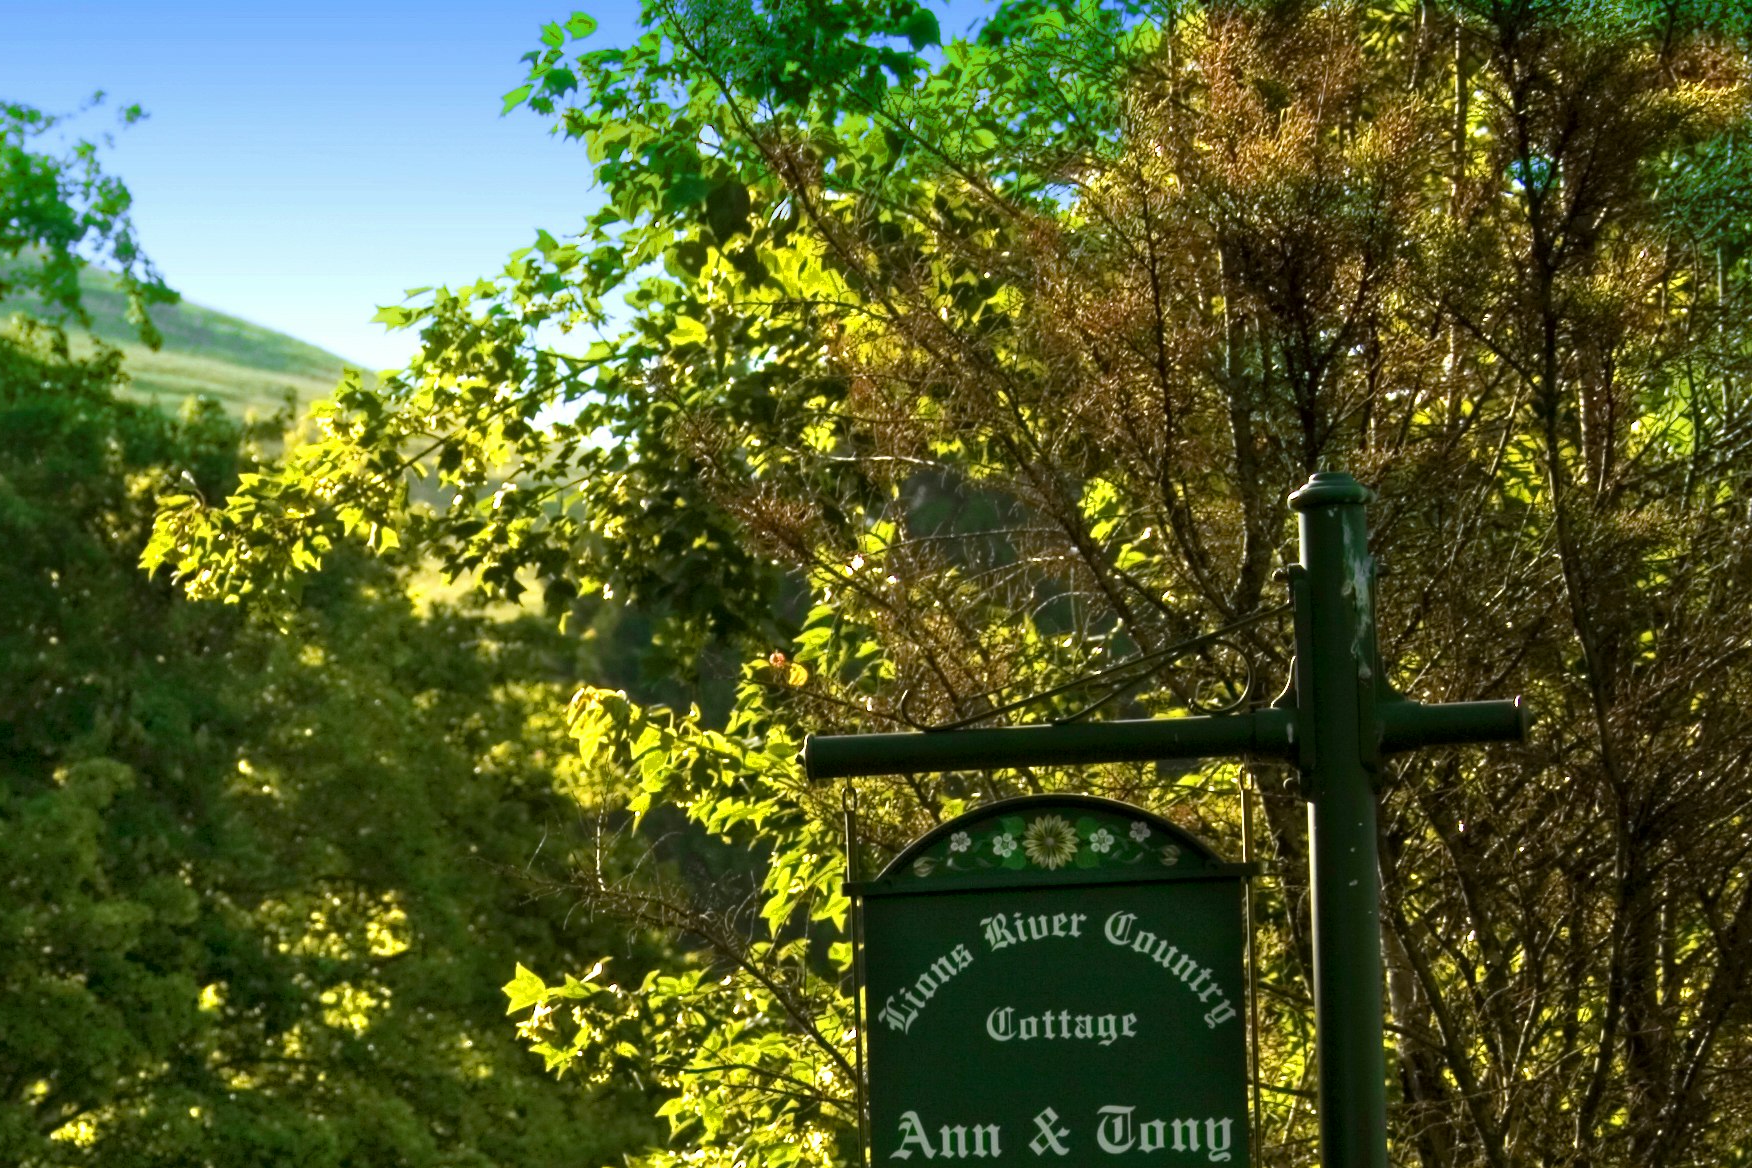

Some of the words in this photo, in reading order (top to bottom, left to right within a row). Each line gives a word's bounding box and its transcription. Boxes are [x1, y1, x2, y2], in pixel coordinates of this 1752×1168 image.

[879, 944, 974, 1034] Lions
[980, 911, 1087, 952] River
[1104, 911, 1236, 1030] Country
[987, 1007, 1138, 1046] Cottage
[890, 1111, 1002, 1160] Ann
[1029, 1107, 1070, 1156] &
[1097, 1105, 1234, 1162] Tony
